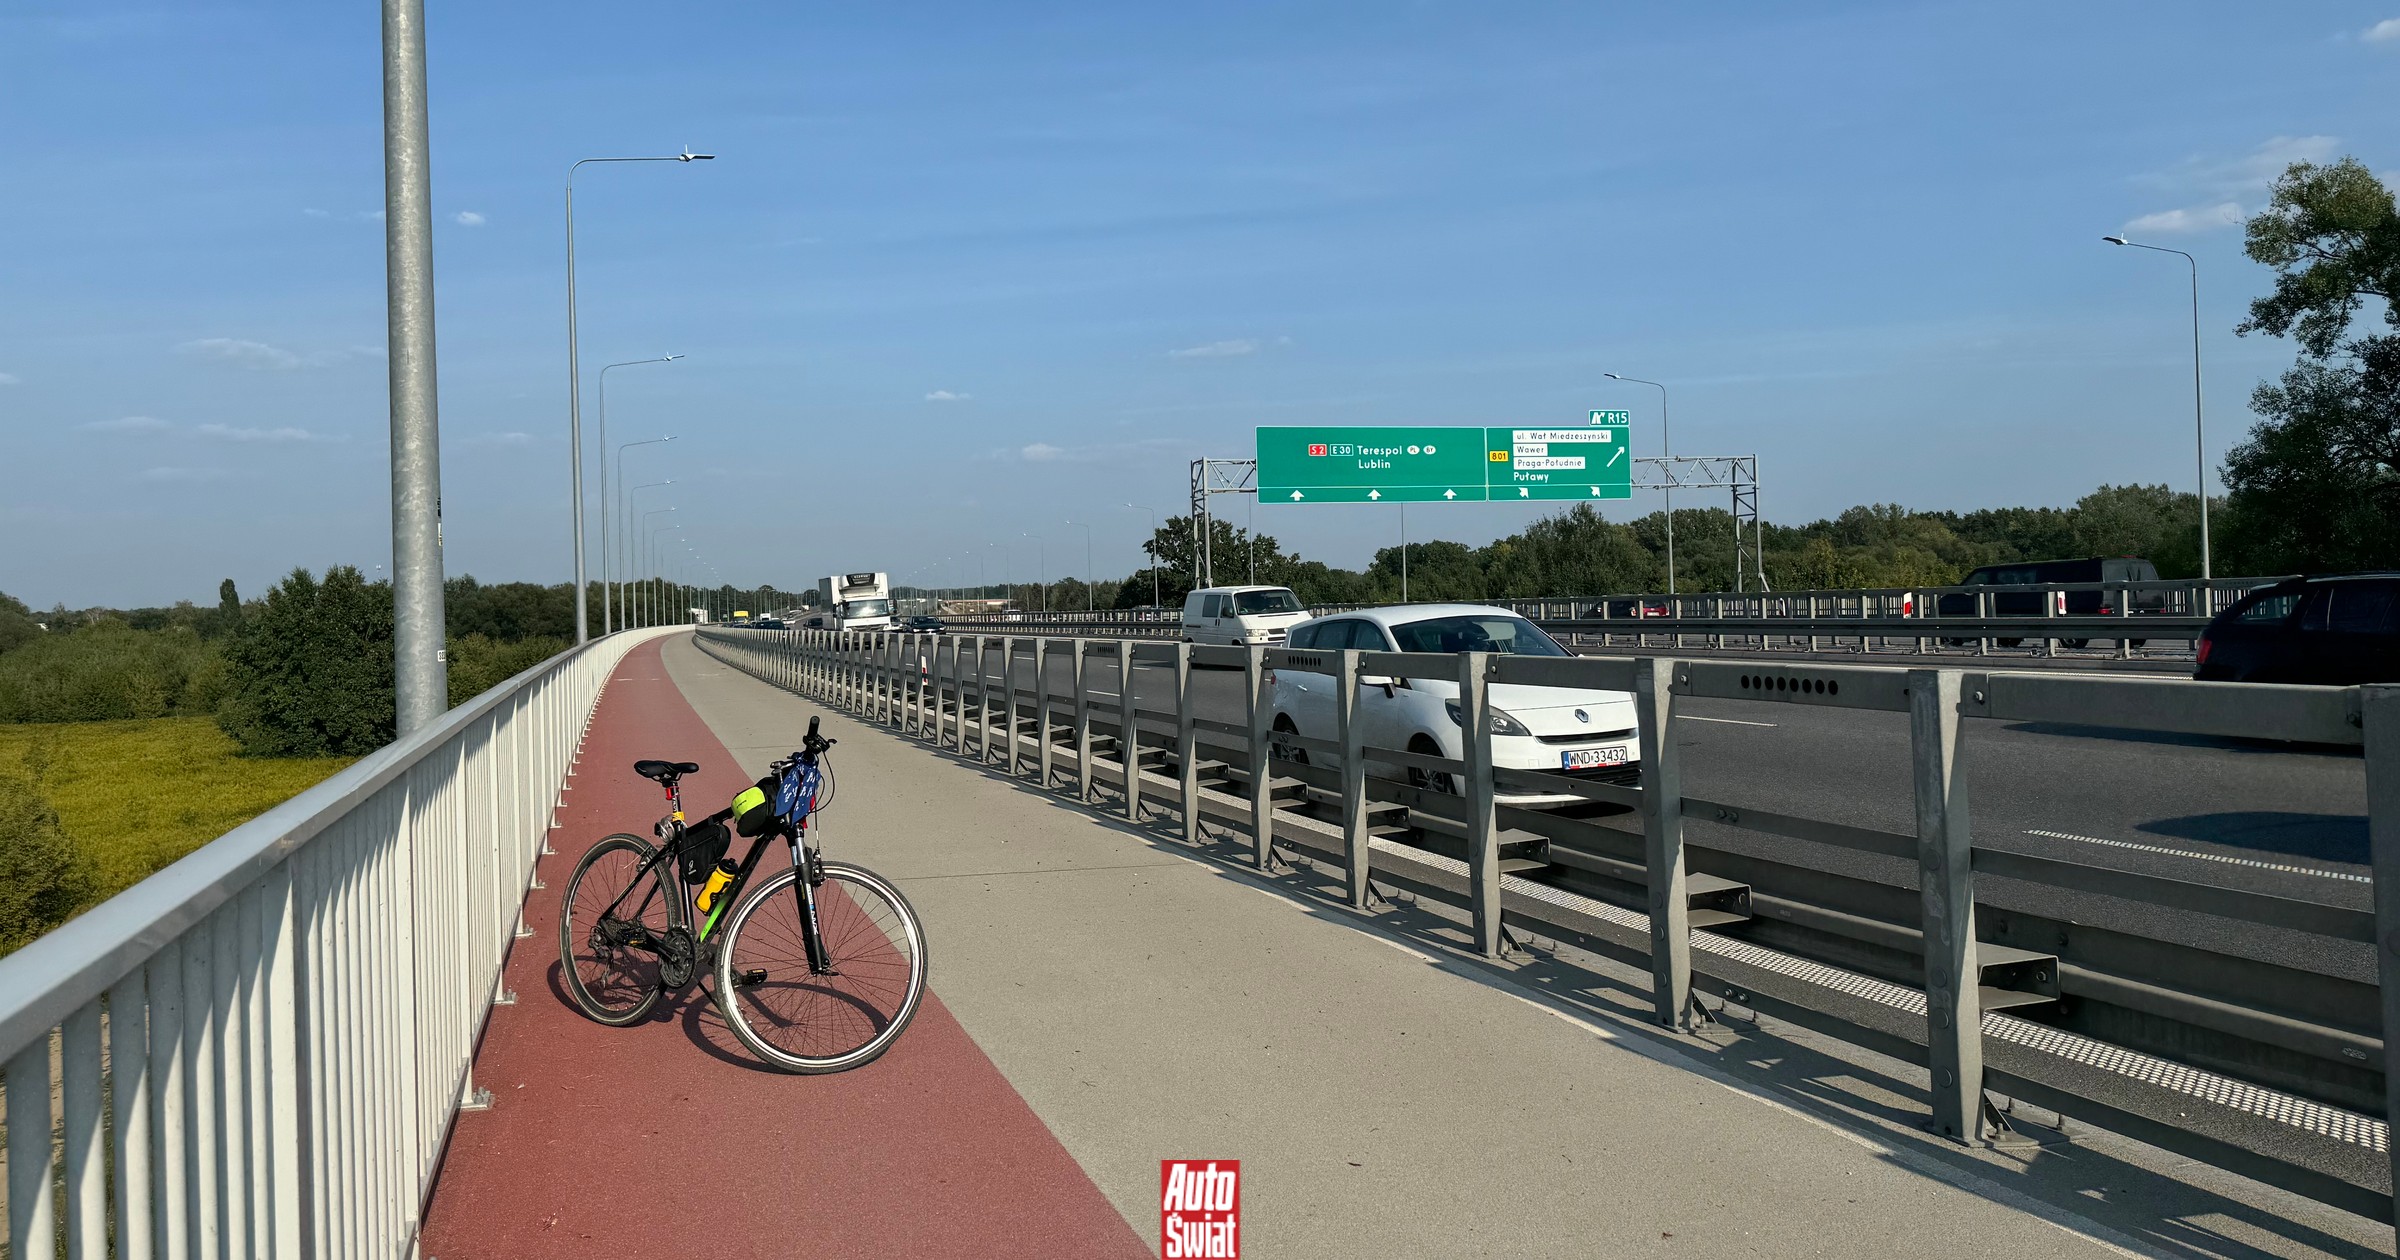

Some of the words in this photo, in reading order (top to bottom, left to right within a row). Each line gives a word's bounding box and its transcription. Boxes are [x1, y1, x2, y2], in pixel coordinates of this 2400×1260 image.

[1607, 412, 1627, 424] R15
[1516, 432, 1527, 440] ul.
[1530, 432, 1547, 440] Wał
[1332, 446, 1338, 455] E
[1339, 446, 1351, 455] 30
[1356, 445, 1403, 458] Terespol
[1516, 446, 1545, 454] Wawer
[1491, 452, 1507, 461] 801
[1358, 459, 1391, 469] Lublin
[1517, 459, 1582, 468] Praga-Południe
[1513, 472, 1549, 483] Puławy
[1569, 752, 1591, 765] WND
[1594, 749, 1625, 763] 33432
